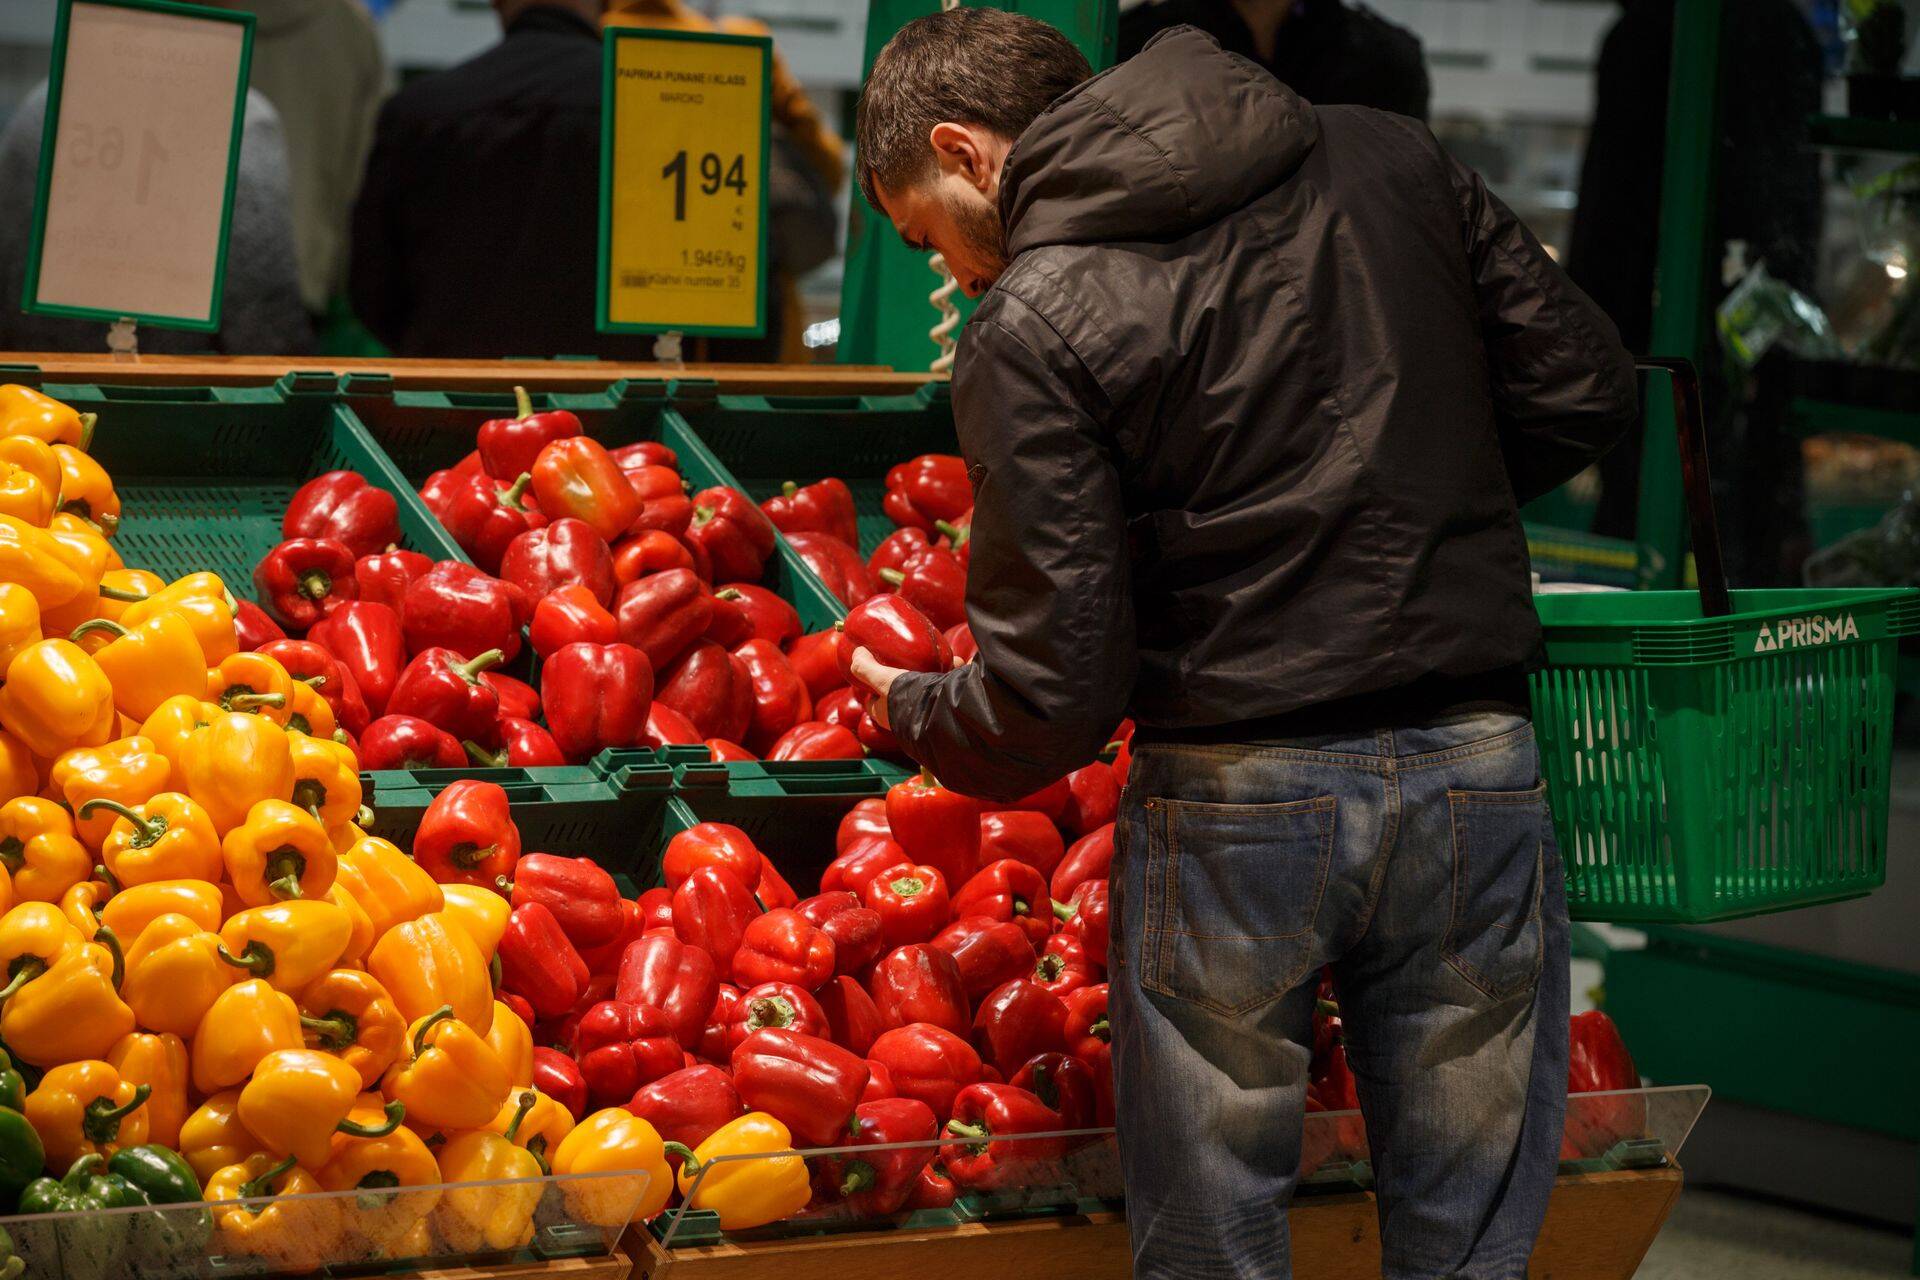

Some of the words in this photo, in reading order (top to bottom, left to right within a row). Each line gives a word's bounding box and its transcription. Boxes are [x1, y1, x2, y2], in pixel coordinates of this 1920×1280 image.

[617, 67, 663, 81] PAPRIKA
[665, 70, 704, 84] PUNANE
[713, 73, 746, 86] KLASS
[1778, 611, 1860, 650] PRISMA
